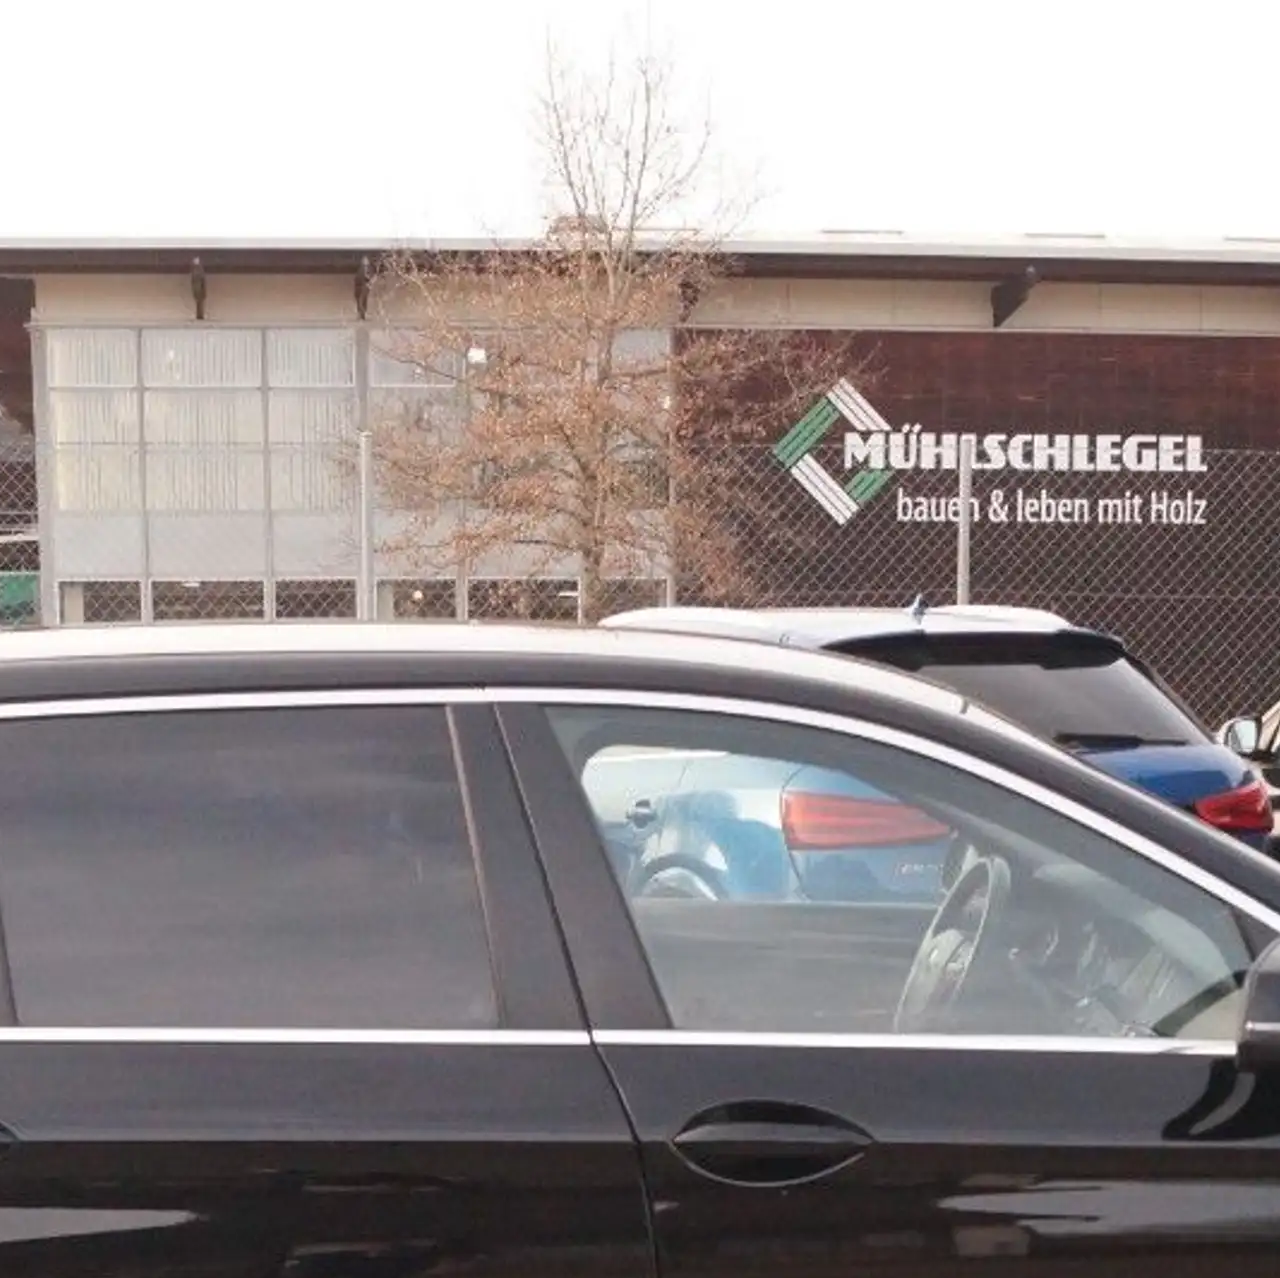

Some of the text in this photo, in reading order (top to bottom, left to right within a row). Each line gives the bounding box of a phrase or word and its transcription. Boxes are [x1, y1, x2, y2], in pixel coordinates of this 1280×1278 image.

[987, 488, 1009, 523] &
[1016, 487, 1091, 524] leben
[1098, 489, 1143, 524] mit
[1150, 489, 1208, 525] Holz
